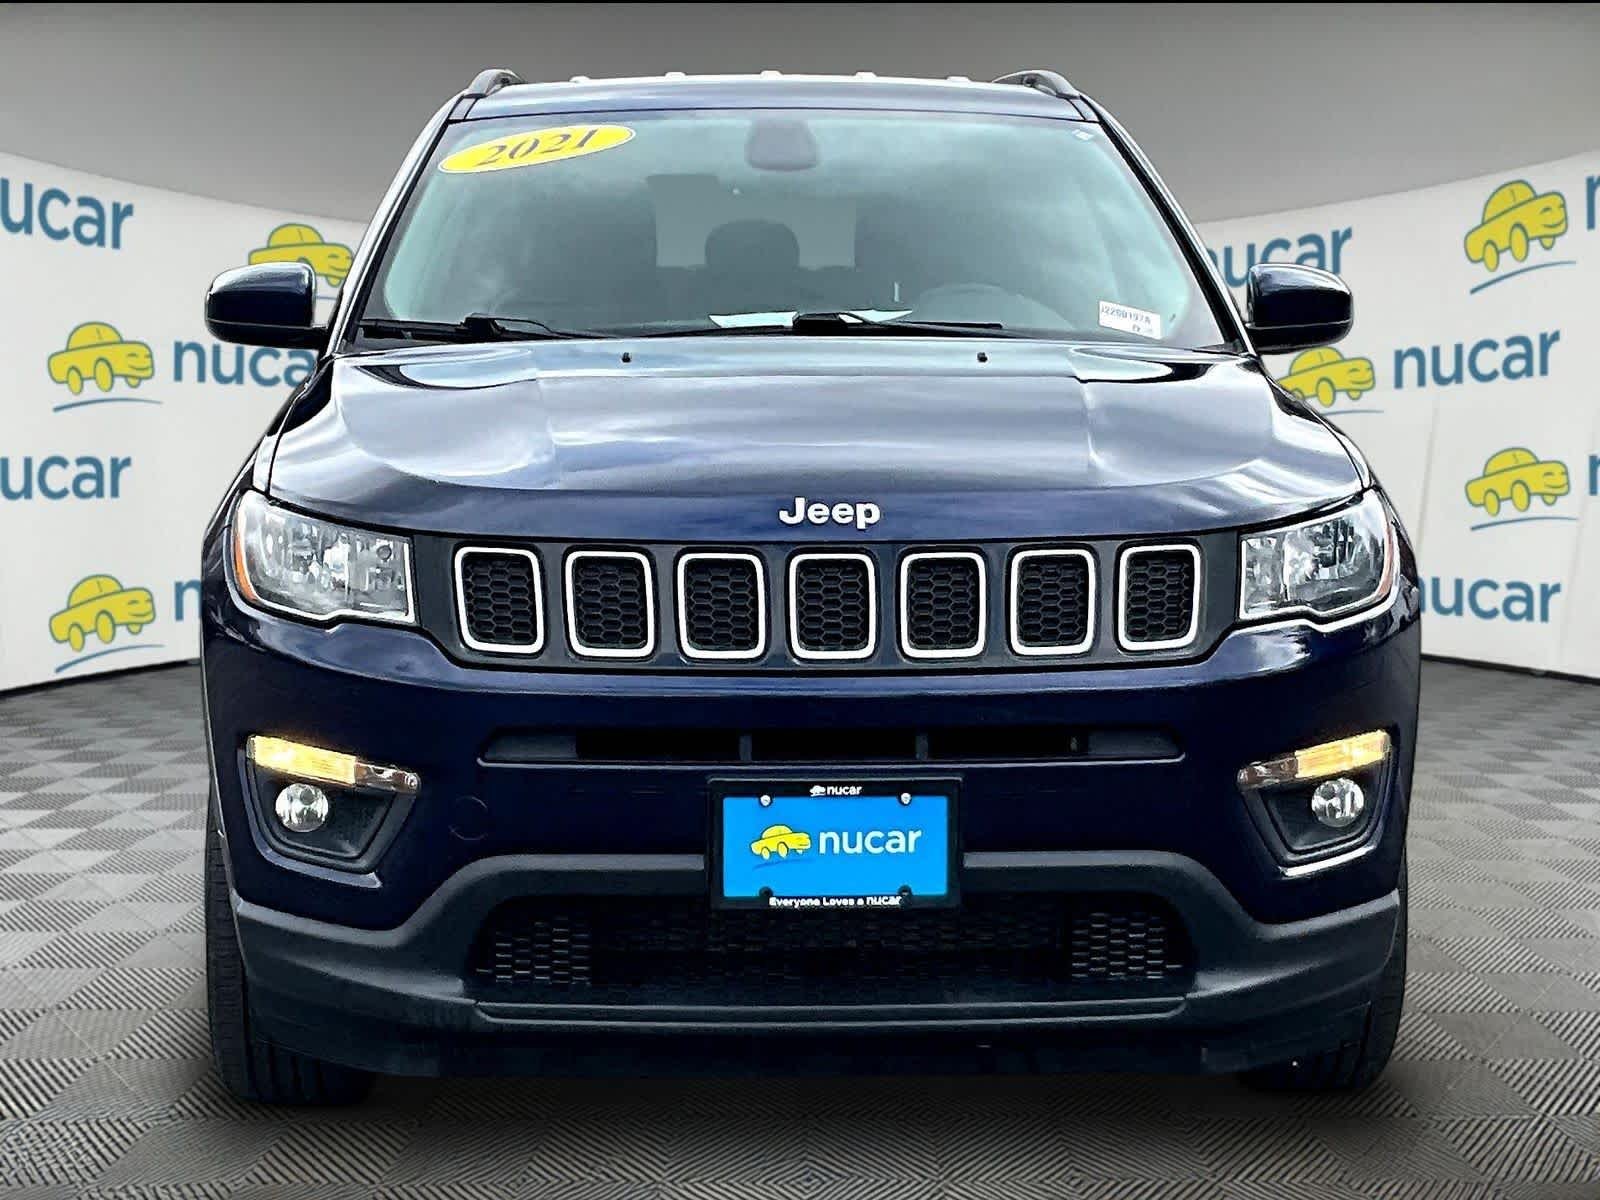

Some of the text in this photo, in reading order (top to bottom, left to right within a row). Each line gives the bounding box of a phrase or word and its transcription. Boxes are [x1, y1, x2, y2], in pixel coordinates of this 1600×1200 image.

[473, 128, 598, 168] 2021
[0, 176, 134, 250] ucar
[1206, 226, 1352, 288] ucar
[173, 340, 317, 389] nuca
[1394, 329, 1561, 389] nucar
[0, 455, 132, 501] ucar
[779, 496, 881, 530] Jeep
[826, 785, 863, 796] nucar
[818, 828, 923, 855] nucar
[769, 896, 820, 909] Everyone
[822, 897, 855, 907] Loves
[866, 896, 902, 906] nucar
